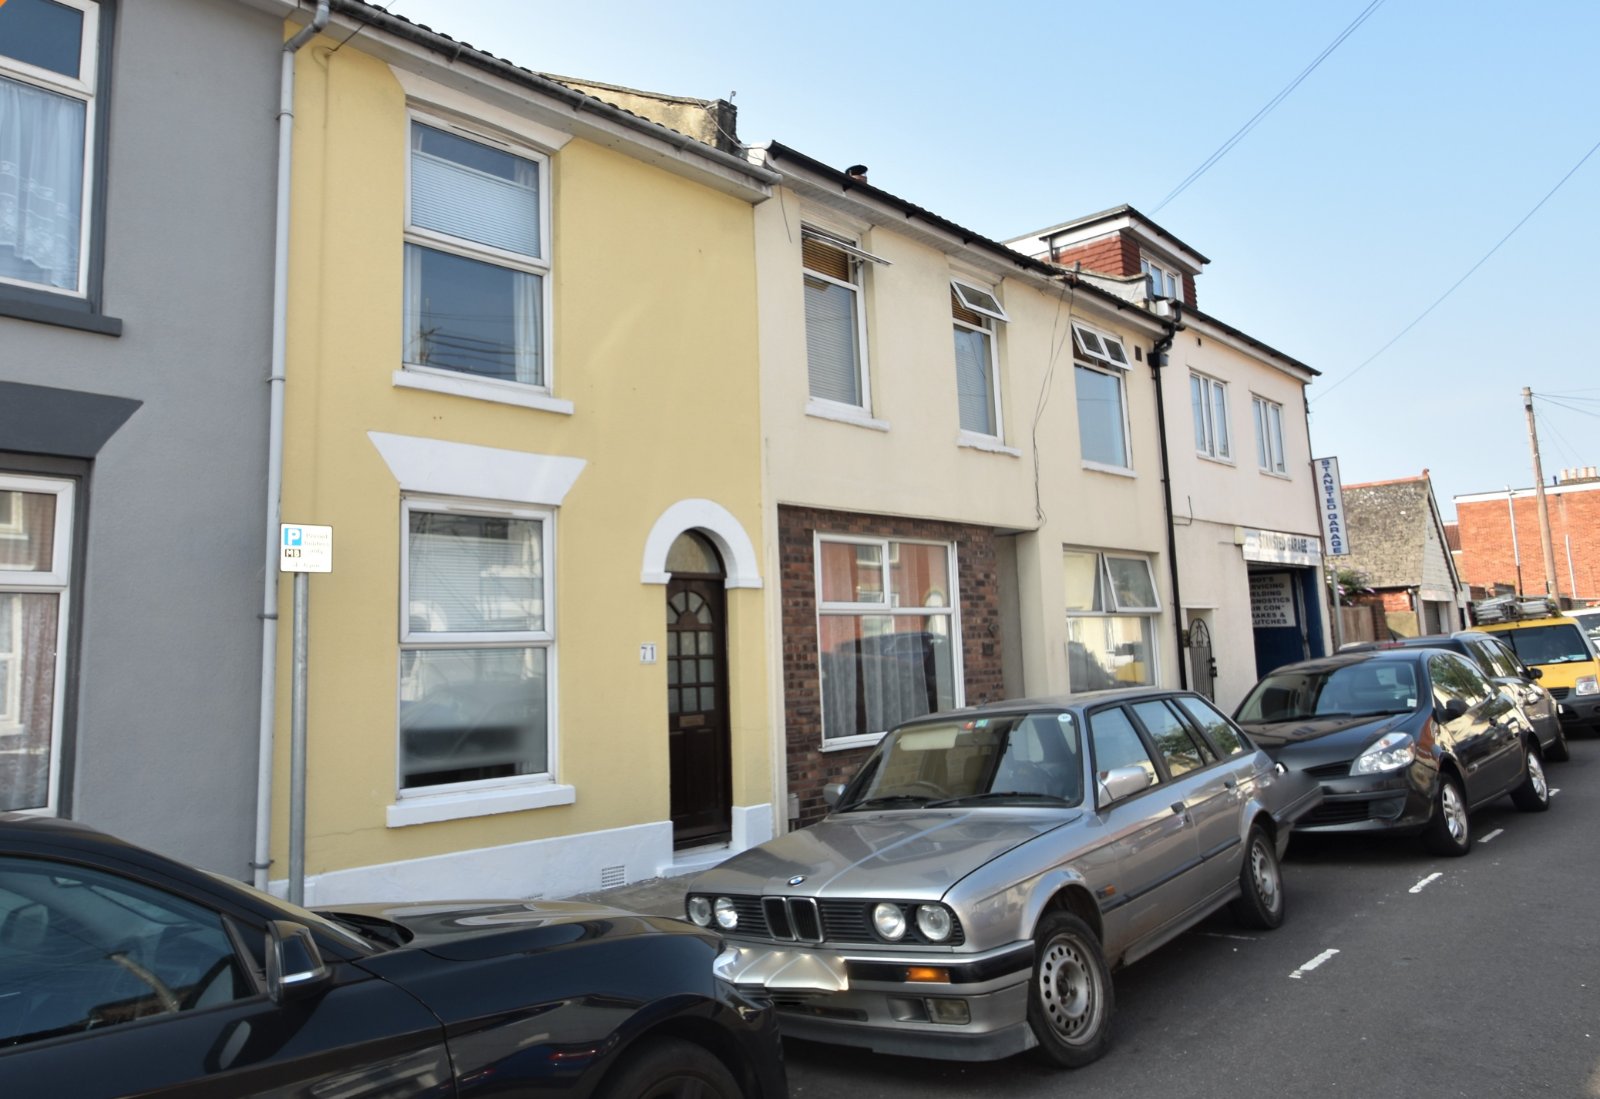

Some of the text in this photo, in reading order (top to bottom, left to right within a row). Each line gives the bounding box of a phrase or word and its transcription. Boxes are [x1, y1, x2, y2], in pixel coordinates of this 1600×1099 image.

[1321, 460, 1342, 554] STANSTED GARAGE
[1251, 597, 1291, 605] GNOSTICS
[641, 646, 655, 660] 71
